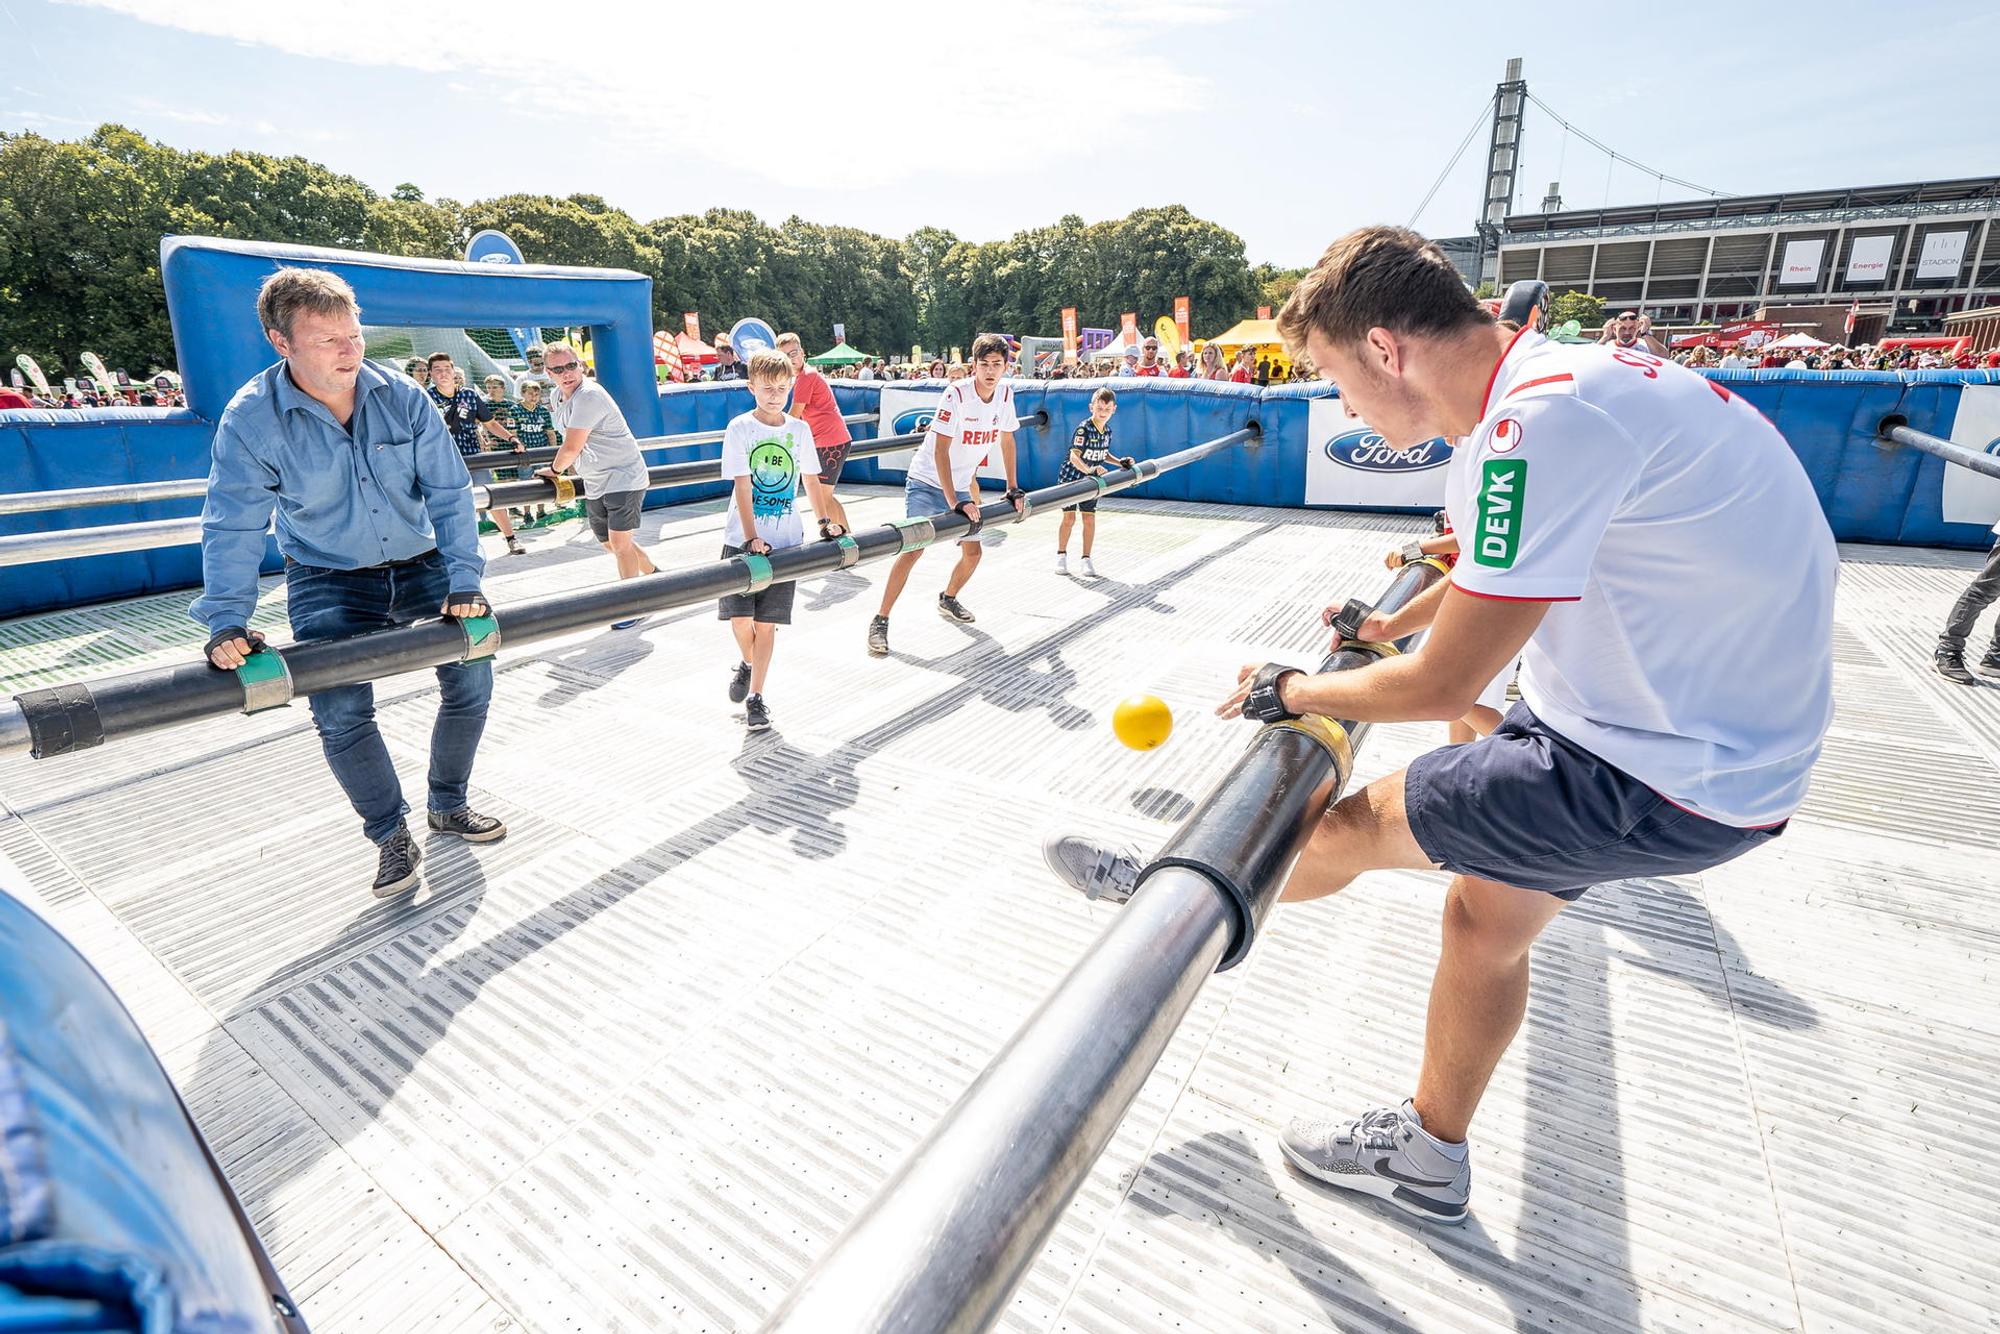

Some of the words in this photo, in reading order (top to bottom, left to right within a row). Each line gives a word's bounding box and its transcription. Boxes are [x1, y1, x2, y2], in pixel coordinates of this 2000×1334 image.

[1852, 262, 1884, 270] Energie
[1921, 258, 1960, 266] STADION
[962, 429, 999, 445] REWE
[1350, 433, 1434, 465] Ford
[771, 455, 783, 467] BE
[1481, 470, 1515, 559] DEVK
